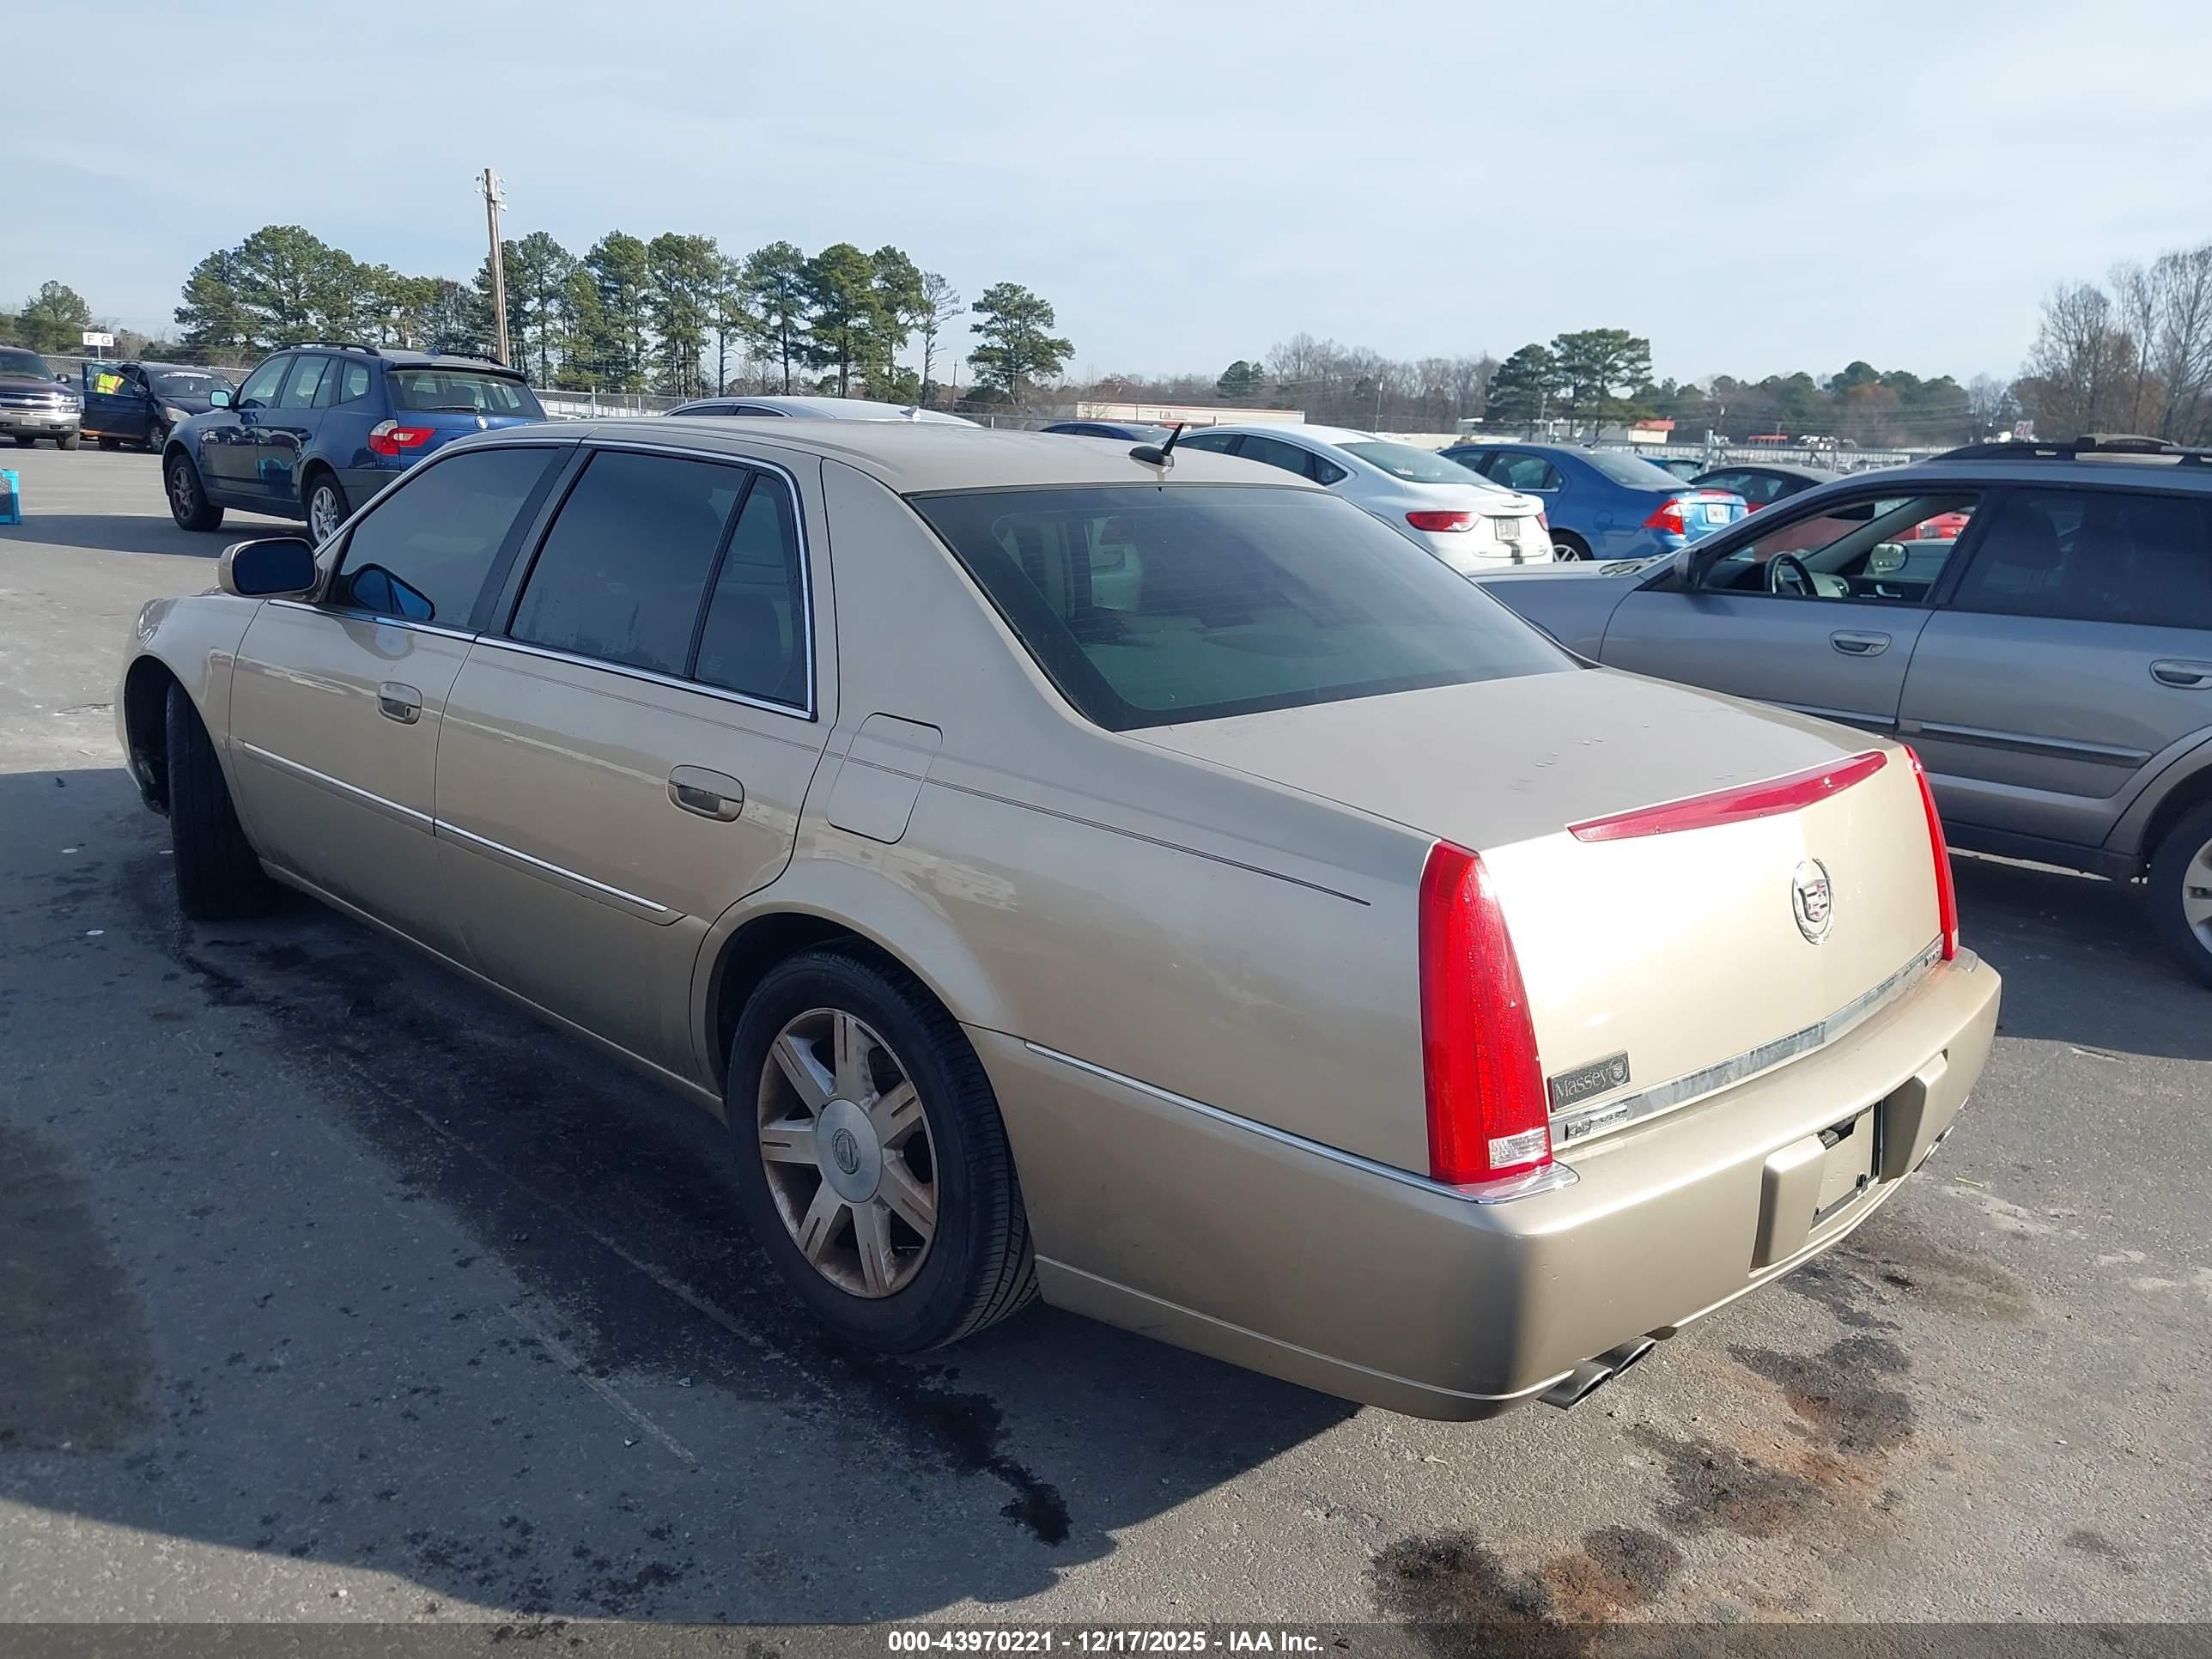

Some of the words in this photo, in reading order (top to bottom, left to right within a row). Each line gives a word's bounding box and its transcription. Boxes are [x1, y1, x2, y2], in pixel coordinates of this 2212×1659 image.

[88, 334, 94, 343] F
[101, 335, 111, 345] G
[1555, 1067, 1609, 1101] Massey
